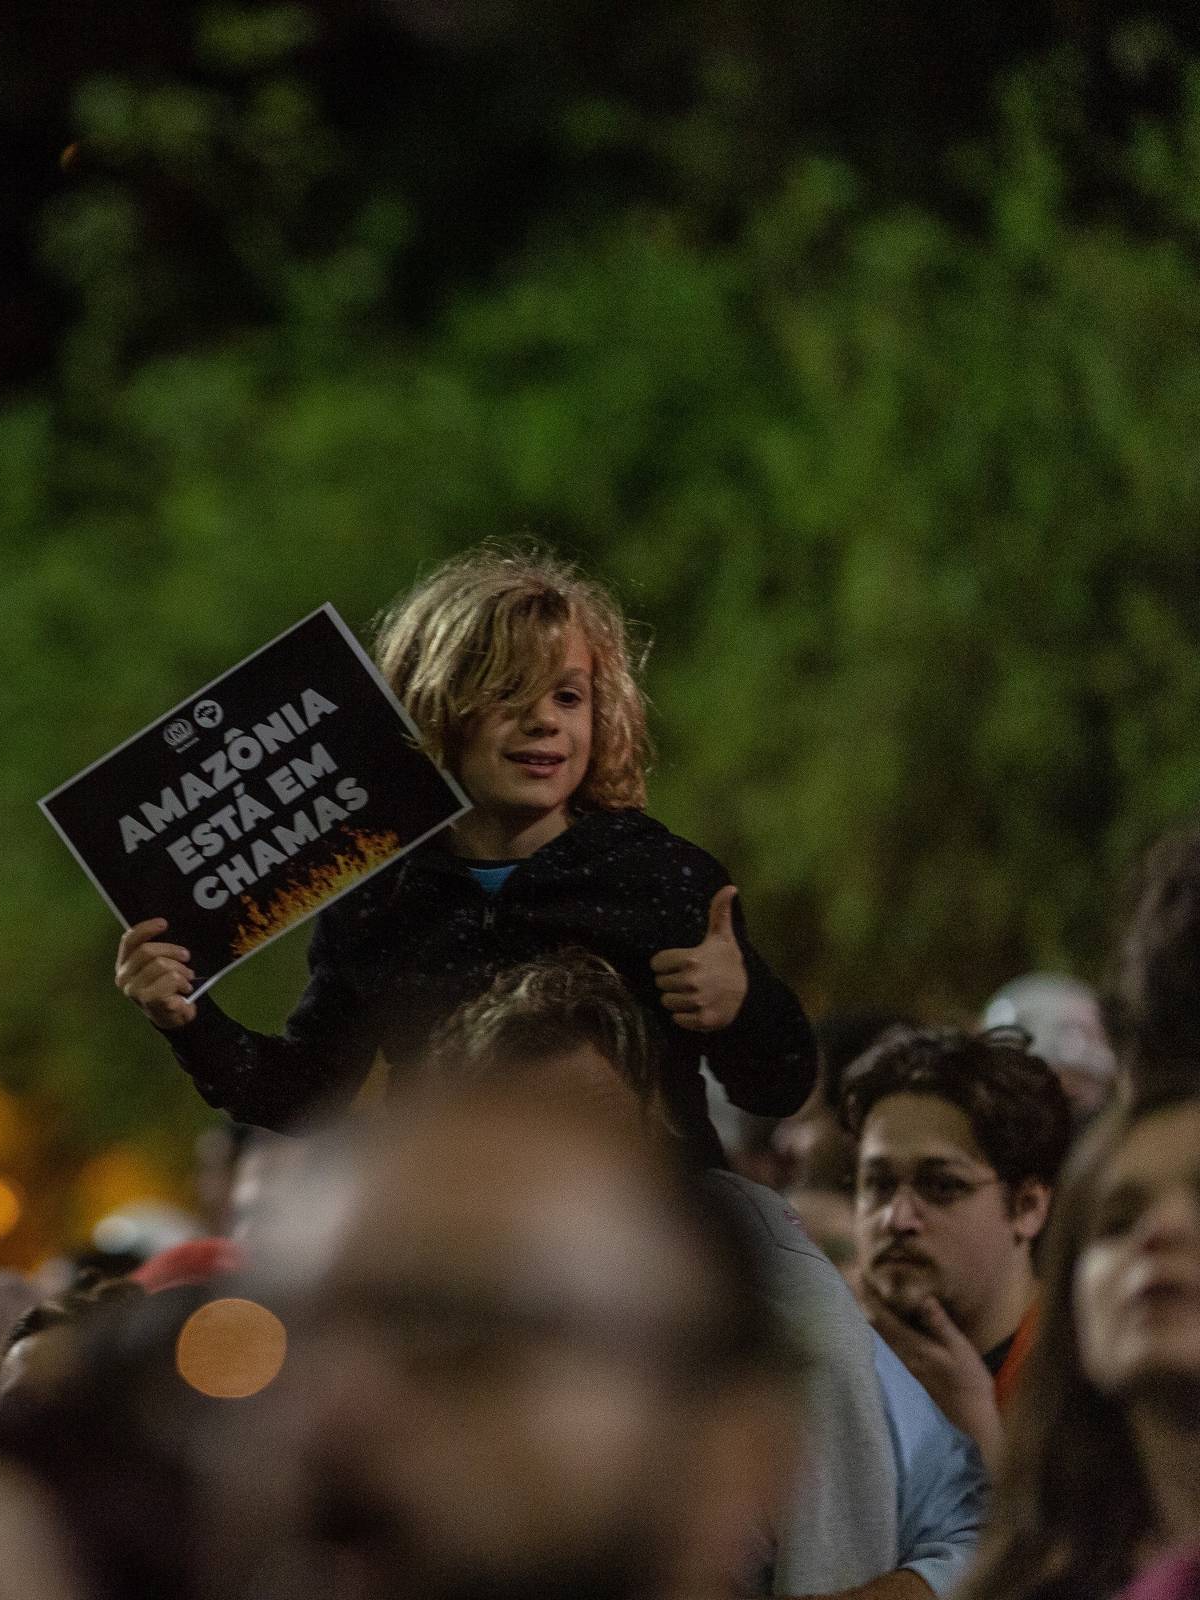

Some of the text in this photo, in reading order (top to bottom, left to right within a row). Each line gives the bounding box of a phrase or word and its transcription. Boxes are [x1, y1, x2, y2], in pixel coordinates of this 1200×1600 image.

[118, 688, 339, 855] AMAZÔNIA
[166, 743, 339, 875] ESTÁ EM
[193, 777, 368, 910] CHAMAS
